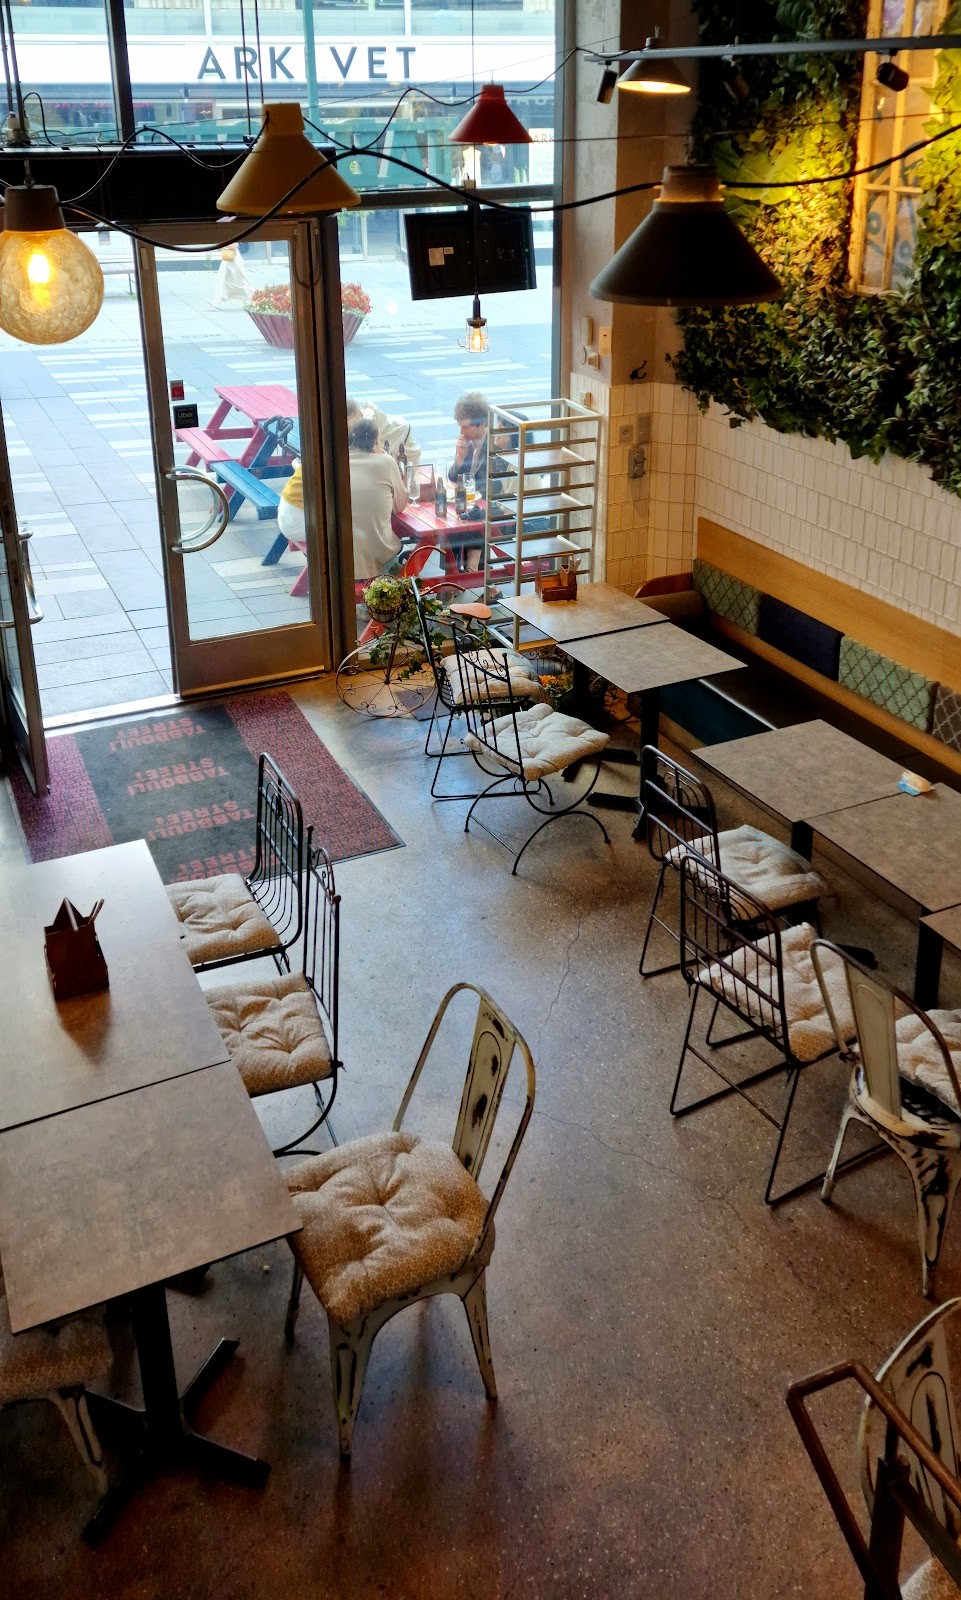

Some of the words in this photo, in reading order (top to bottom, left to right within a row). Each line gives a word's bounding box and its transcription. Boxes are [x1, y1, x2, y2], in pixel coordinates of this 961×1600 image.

[109, 725, 206, 751] TABBOULI
[116, 717, 193, 739] STREET
[127, 766, 230, 796] TABBOULI
[135, 758, 215, 780] STREET
[147, 808, 255, 841] TABBOULI
[156, 800, 239, 825] STREET
